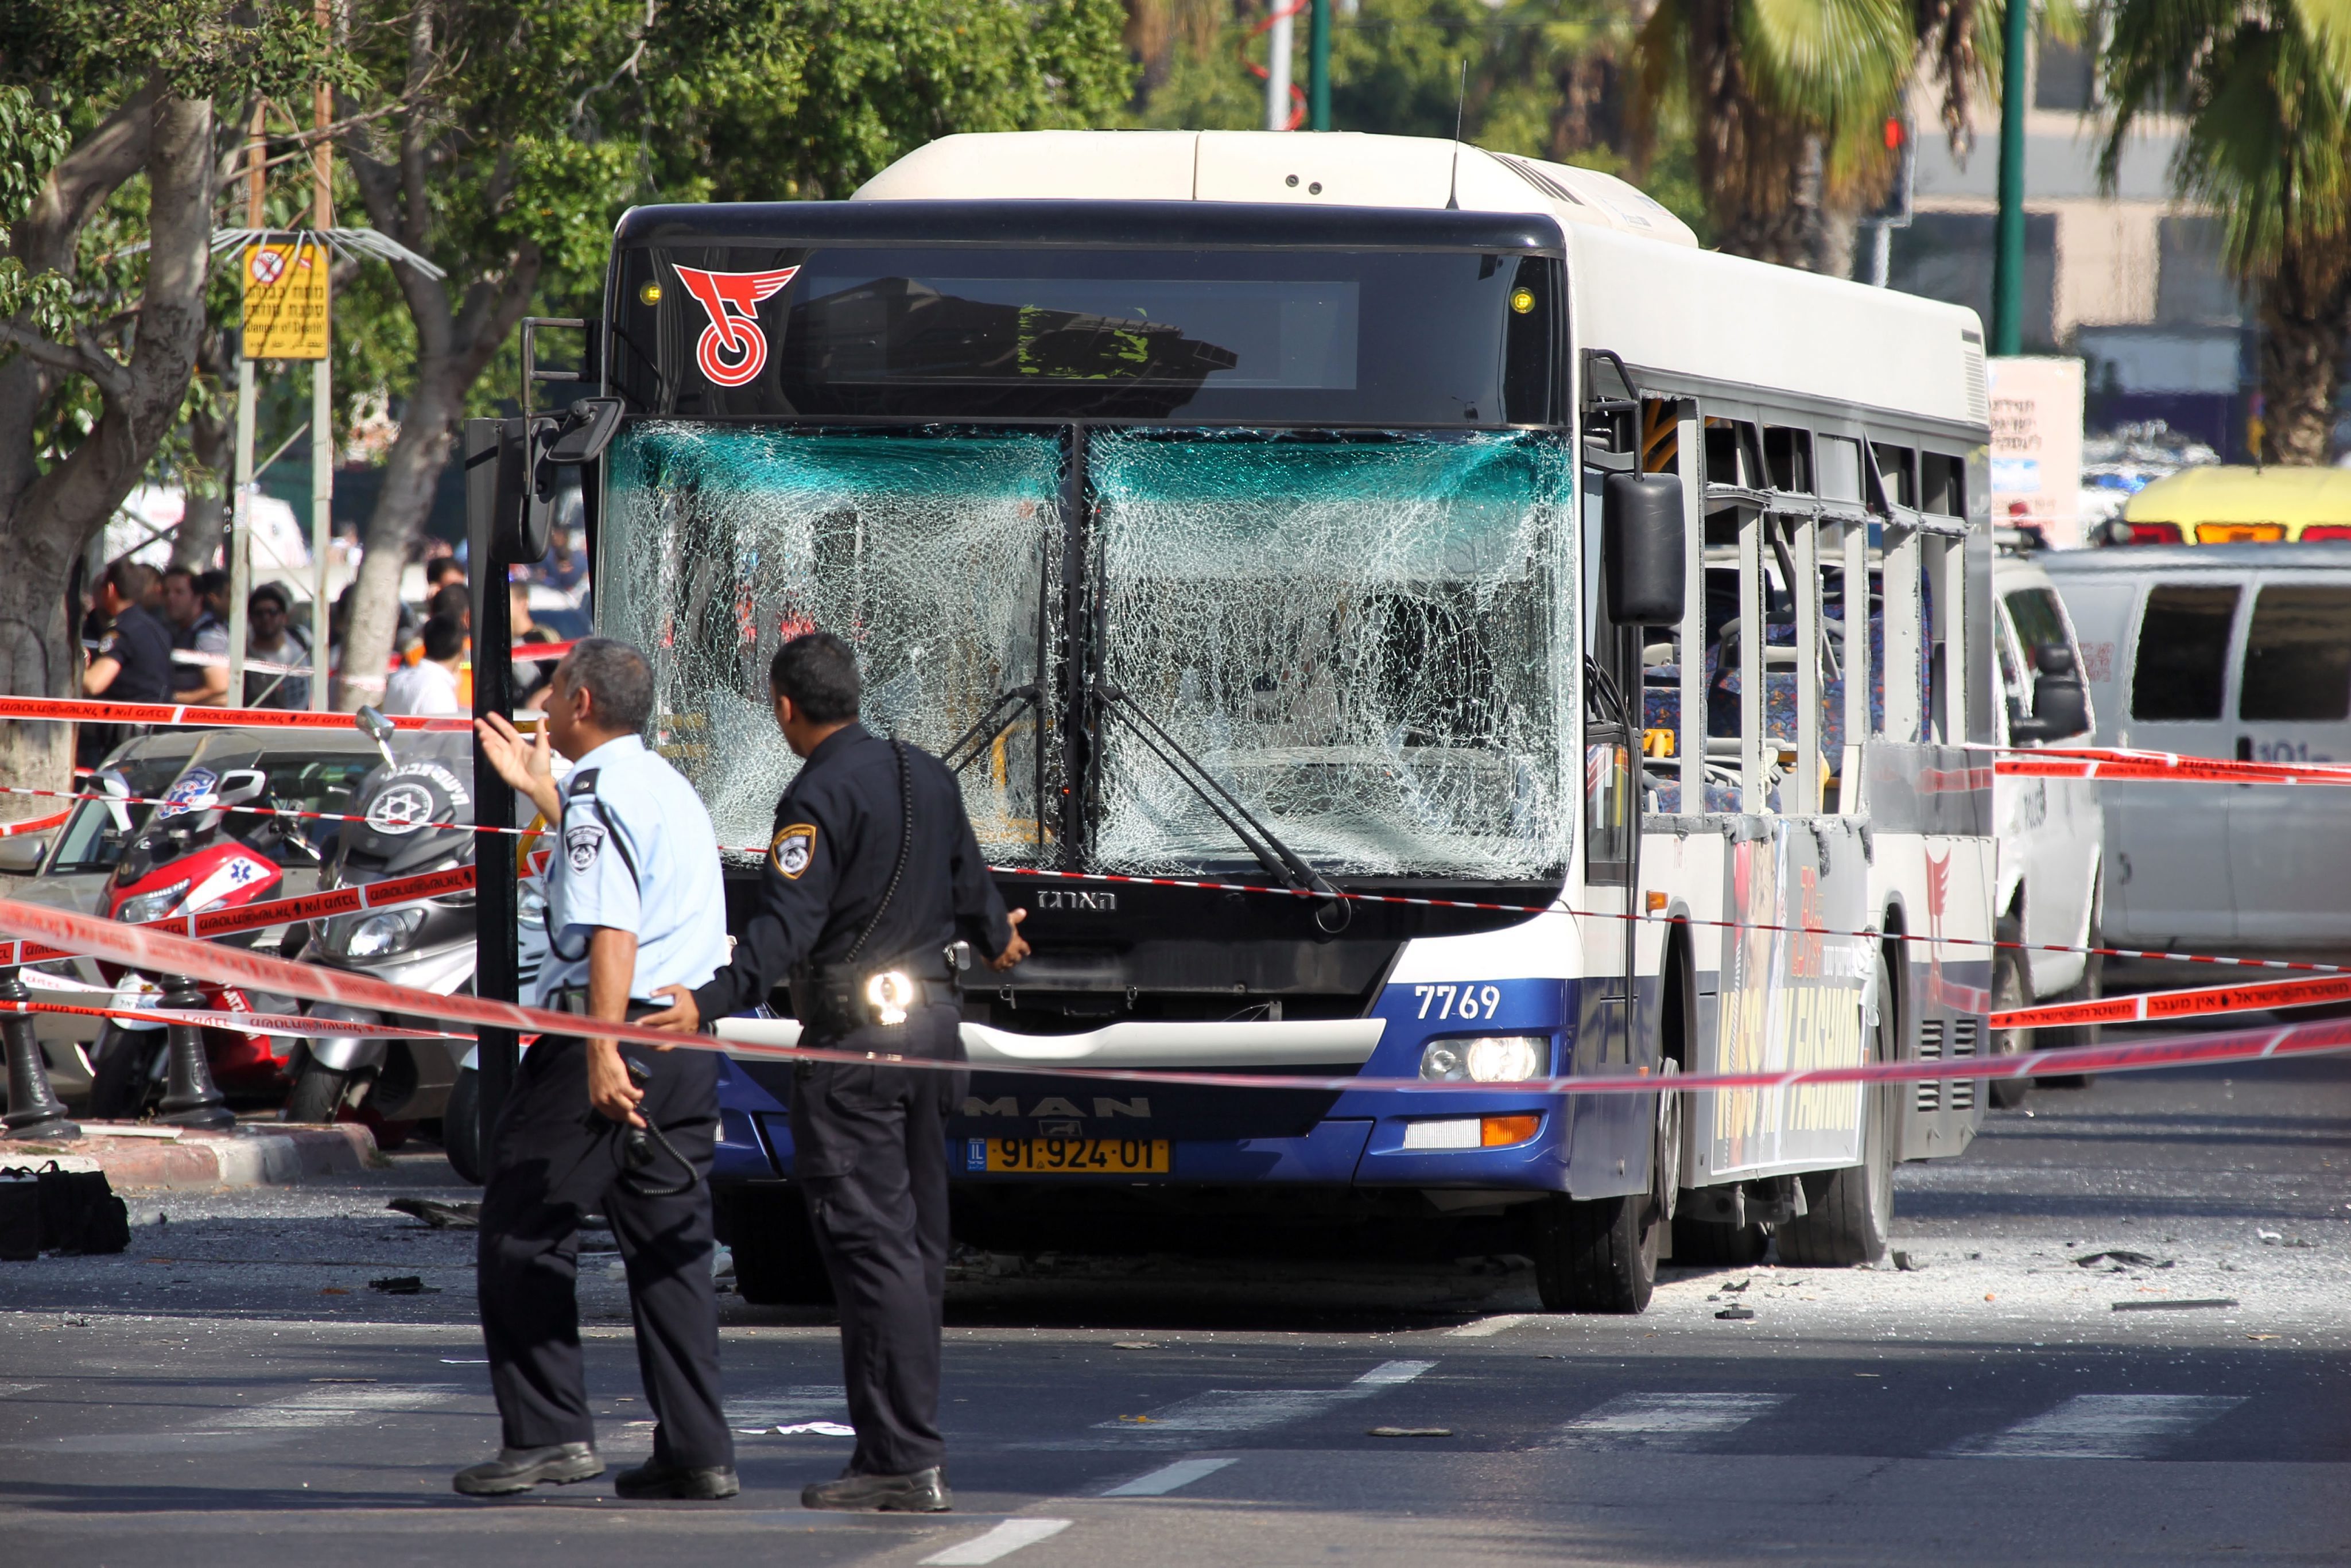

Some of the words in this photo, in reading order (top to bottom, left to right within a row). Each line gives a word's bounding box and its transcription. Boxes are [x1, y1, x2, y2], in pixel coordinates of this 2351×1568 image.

[1037, 891, 1116, 910] הארגז
[1415, 985, 1500, 1019] 7769
[964, 1097, 1151, 1117] MAN
[972, 1144, 983, 1159] IL
